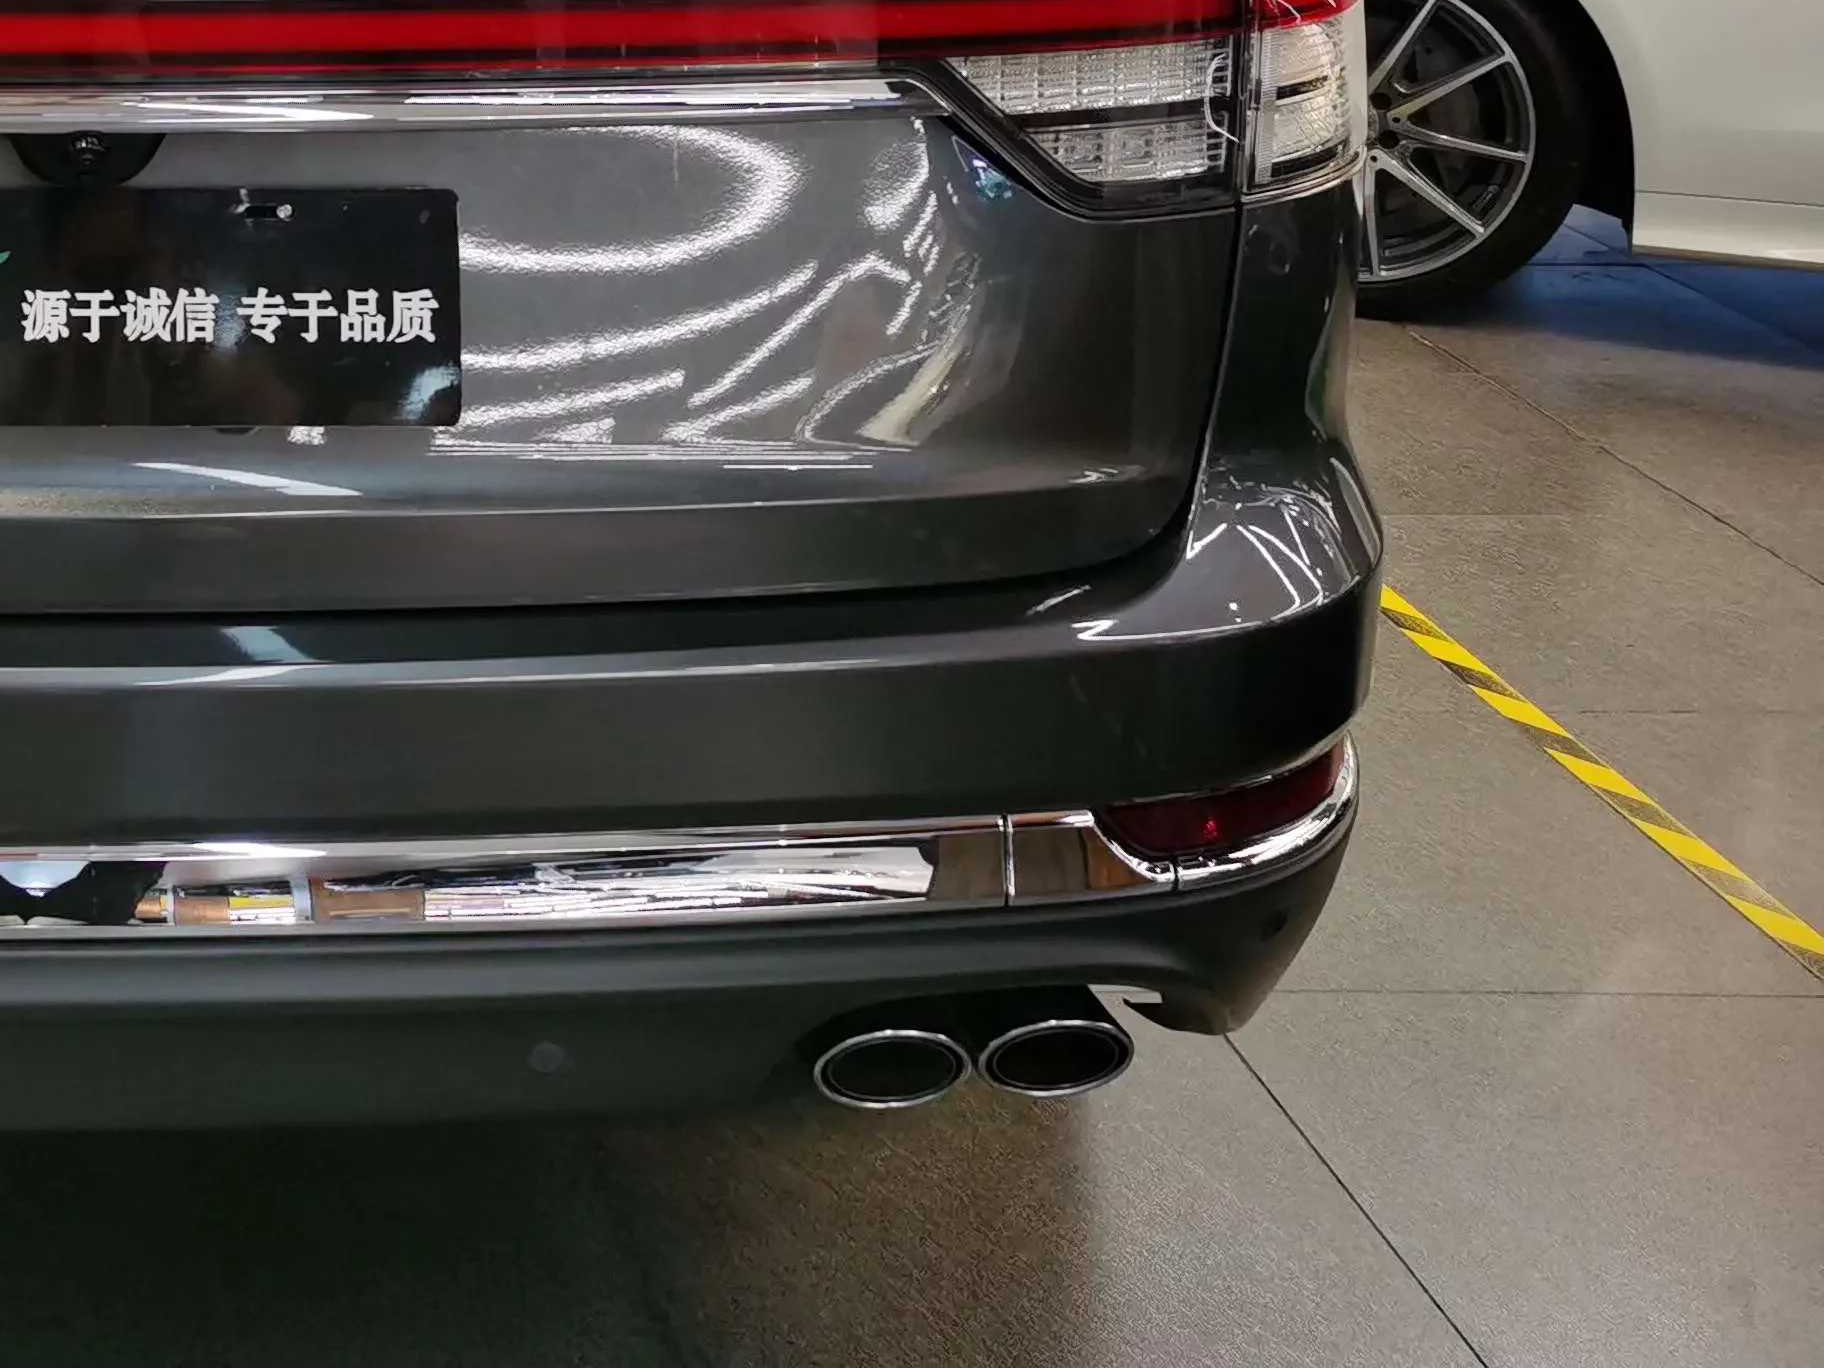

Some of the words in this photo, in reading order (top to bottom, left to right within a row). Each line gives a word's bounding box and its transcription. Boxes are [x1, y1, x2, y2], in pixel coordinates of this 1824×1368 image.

[21, 287, 219, 343] 源于诚信
[236, 287, 440, 343] 专于品质
